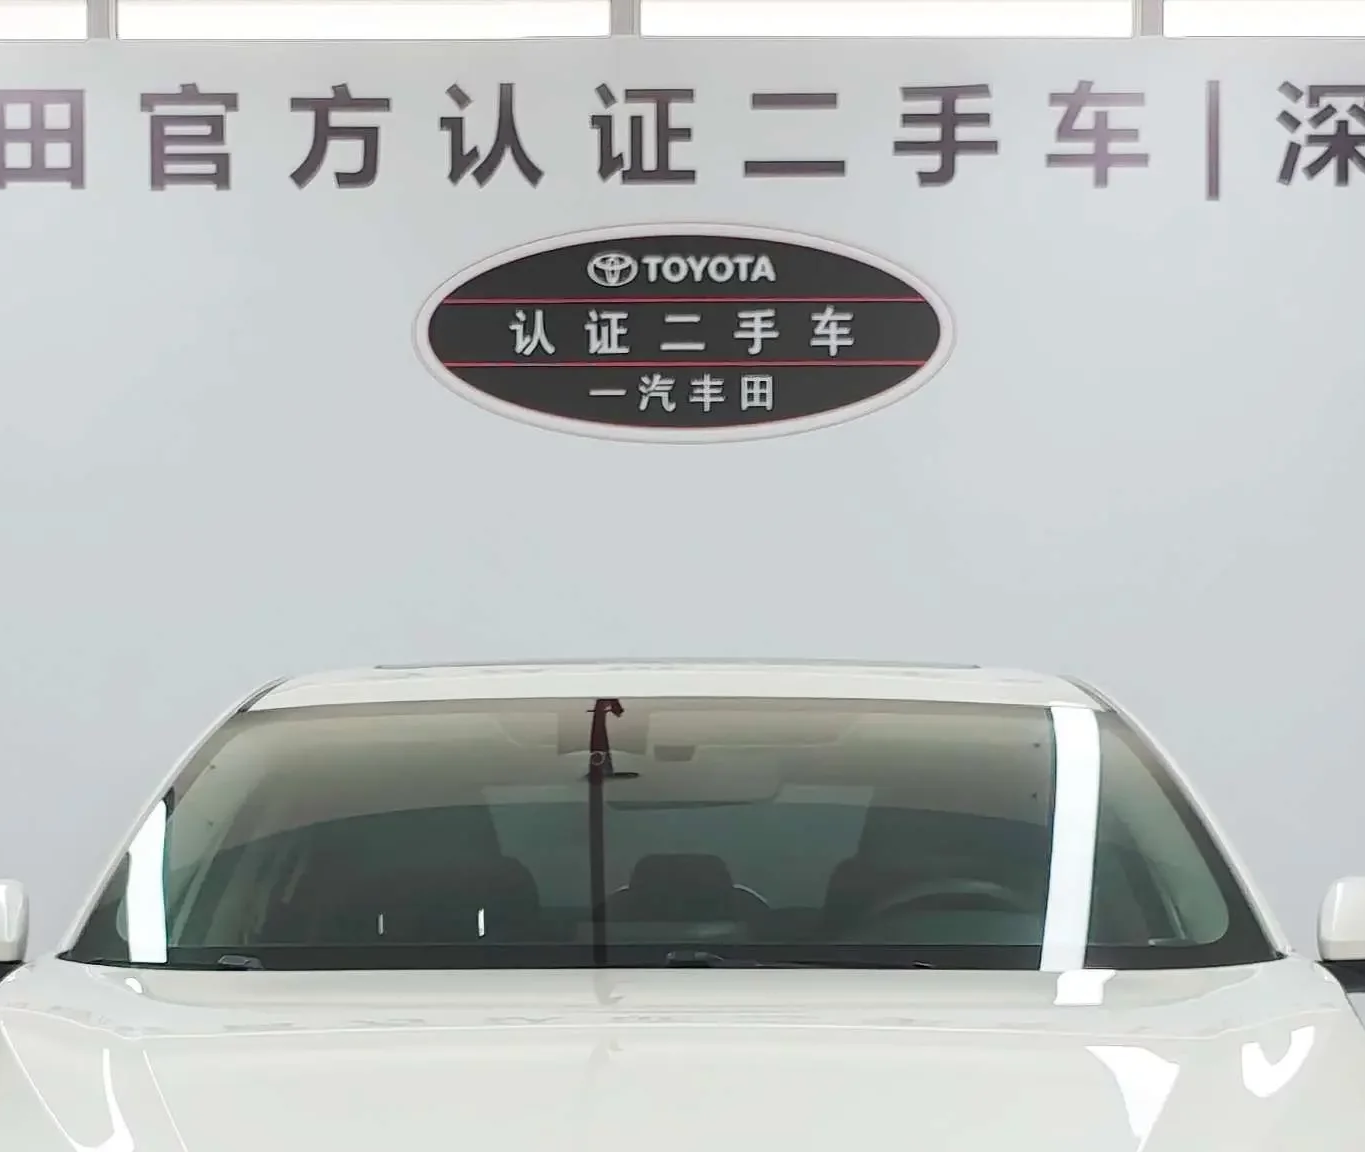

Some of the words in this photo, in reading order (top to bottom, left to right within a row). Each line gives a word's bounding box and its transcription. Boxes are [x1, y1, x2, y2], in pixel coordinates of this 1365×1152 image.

[641, 254, 777, 283] TOYOTA
[509, 305, 854, 356] 认证二手车
[589, 373, 774, 412] 一汽丰田
